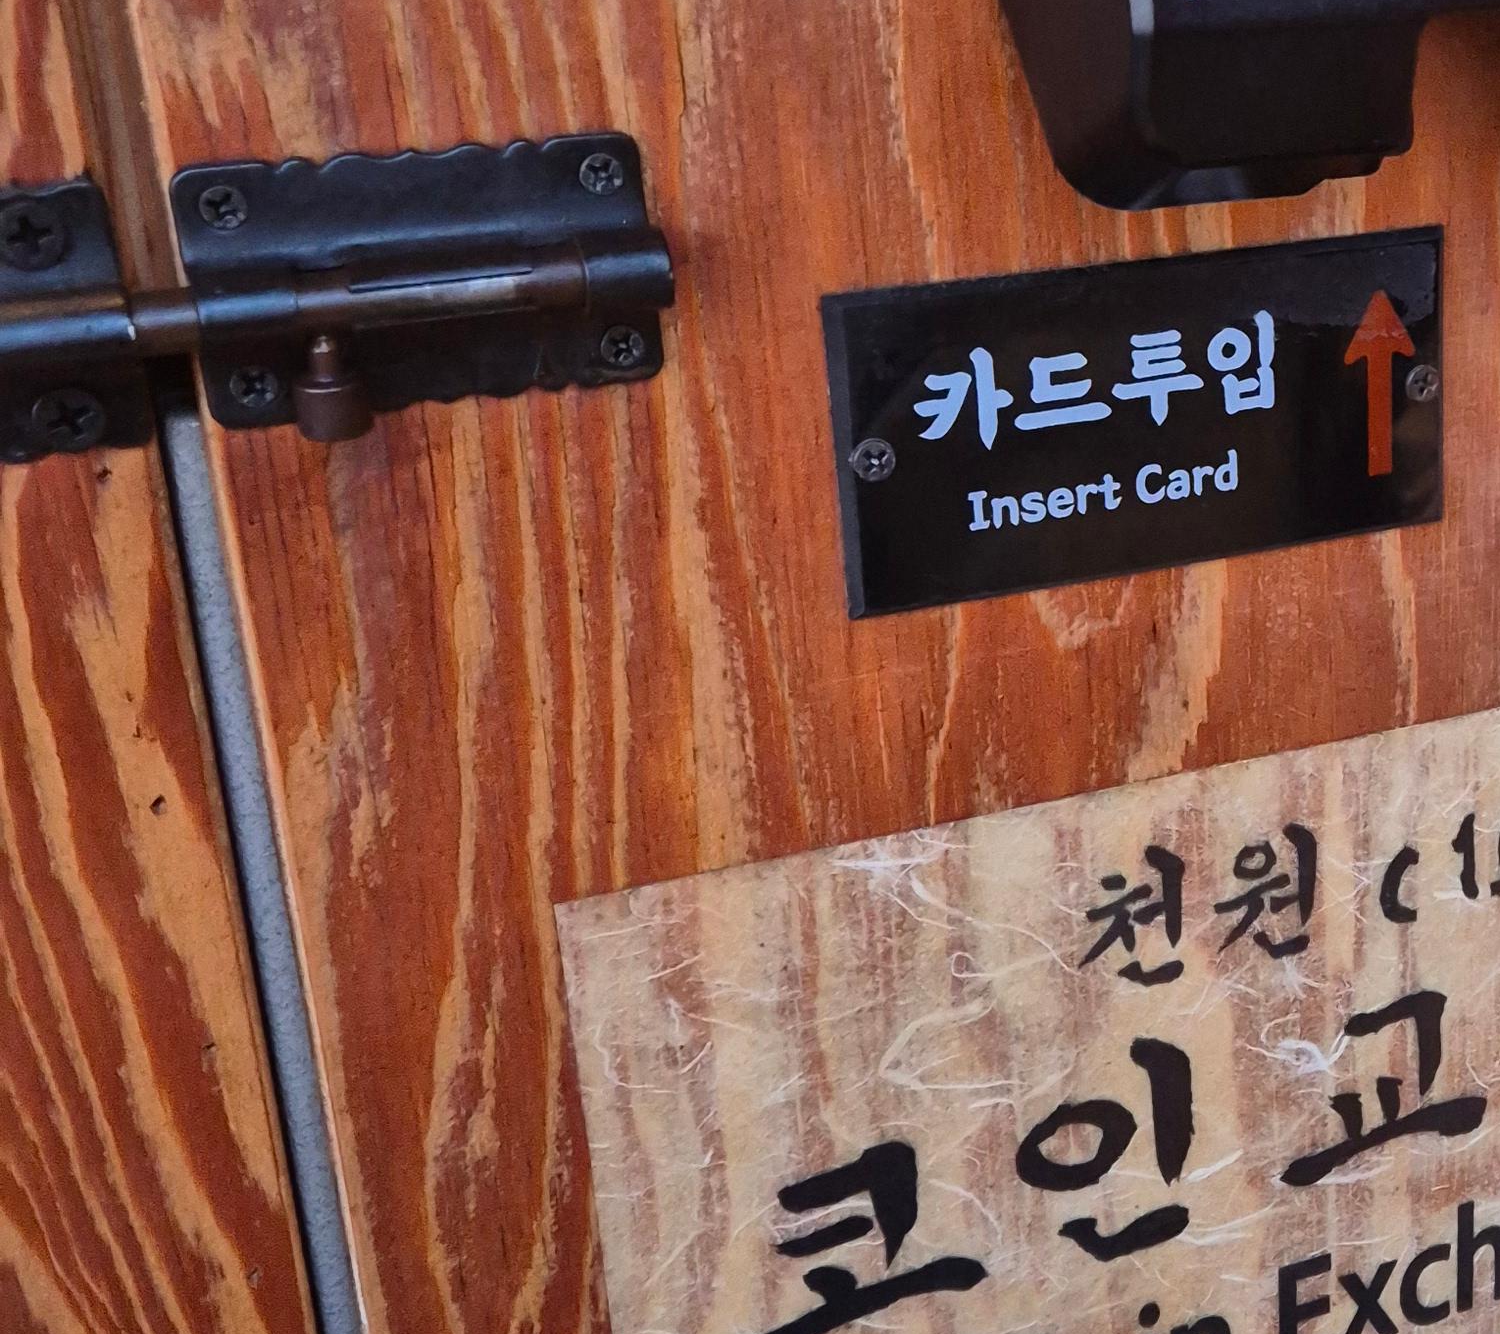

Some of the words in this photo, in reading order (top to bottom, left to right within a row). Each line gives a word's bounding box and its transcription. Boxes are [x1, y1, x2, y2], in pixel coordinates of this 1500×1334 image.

[913, 309, 1276, 451] 카드투입
[967, 472, 1122, 532] Insert
[1135, 448, 1239, 505] Card
